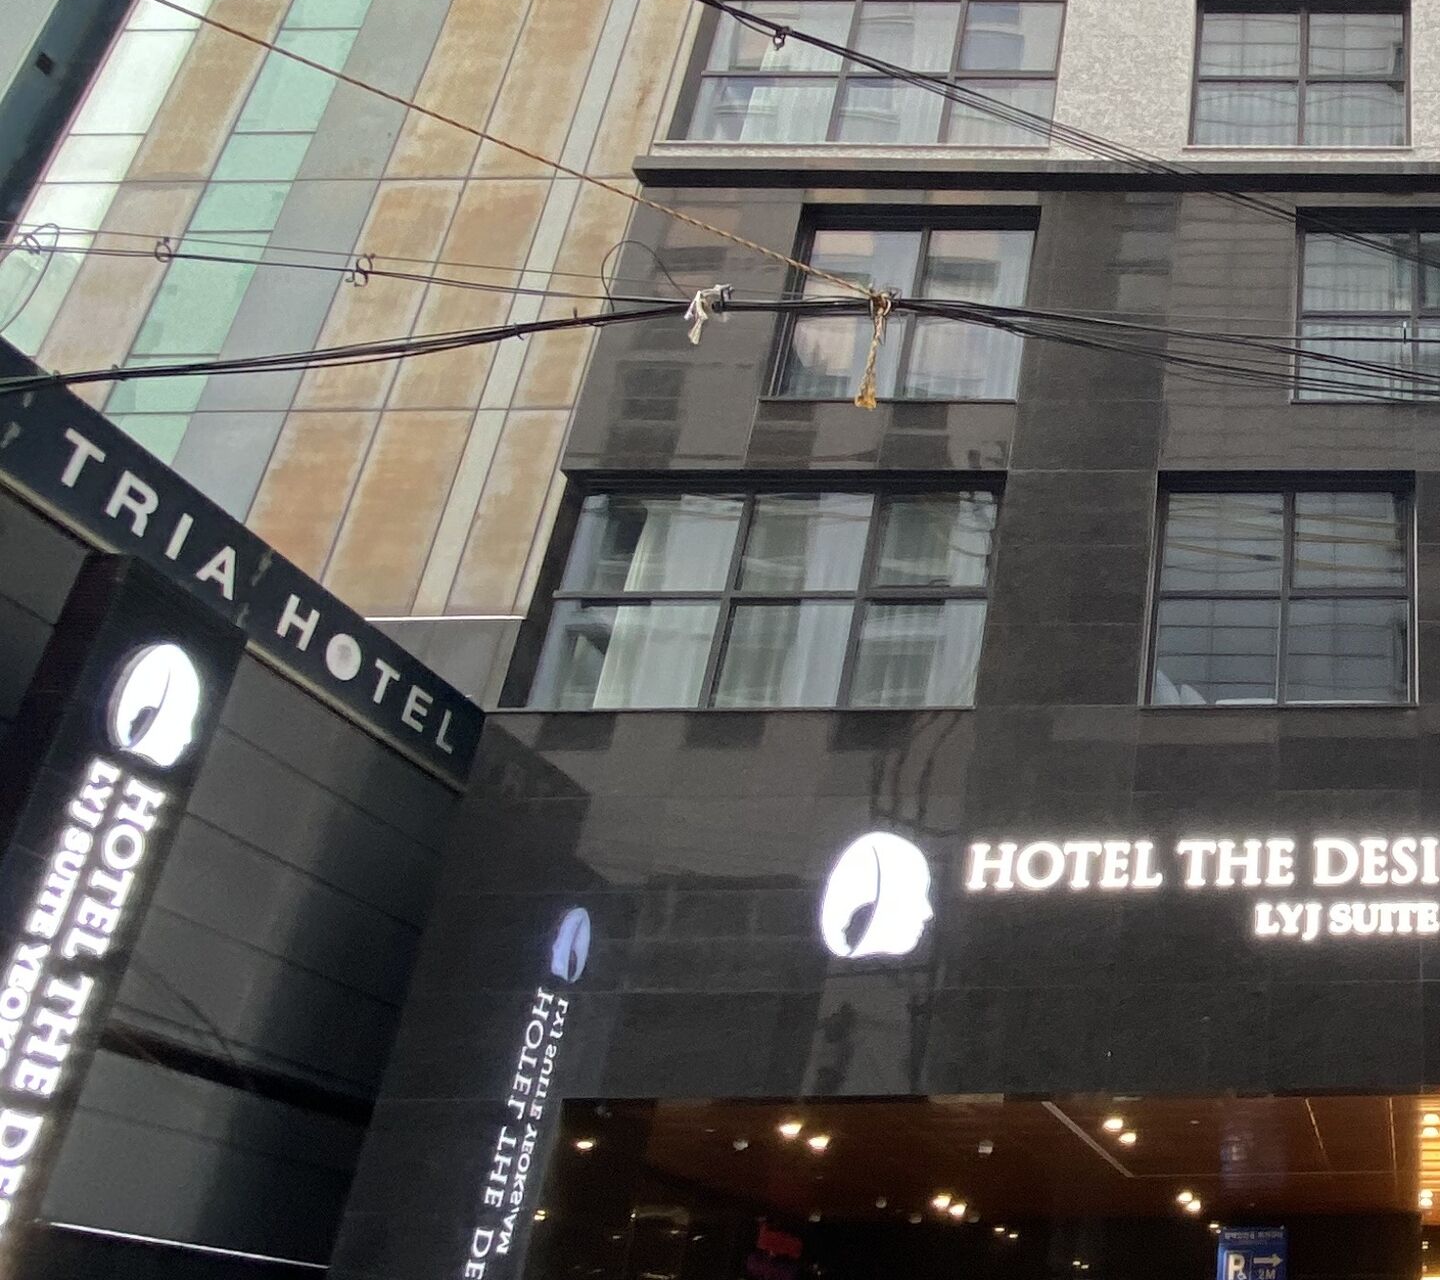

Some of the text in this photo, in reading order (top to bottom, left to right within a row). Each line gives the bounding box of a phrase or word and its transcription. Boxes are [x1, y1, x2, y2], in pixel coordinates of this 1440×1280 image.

[60, 427, 454, 755] TRIA HOTEL
[68, 758, 122, 828] LYJ
[24, 826, 93, 939] SUITE
[62, 777, 166, 959] HOTEL
[965, 839, 1164, 891] HOTEL
[1176, 837, 1296, 888] THE
[1254, 901, 1322, 942] LYJ
[1327, 900, 1440, 935] SUITE
[12, 973, 96, 1098] THE
